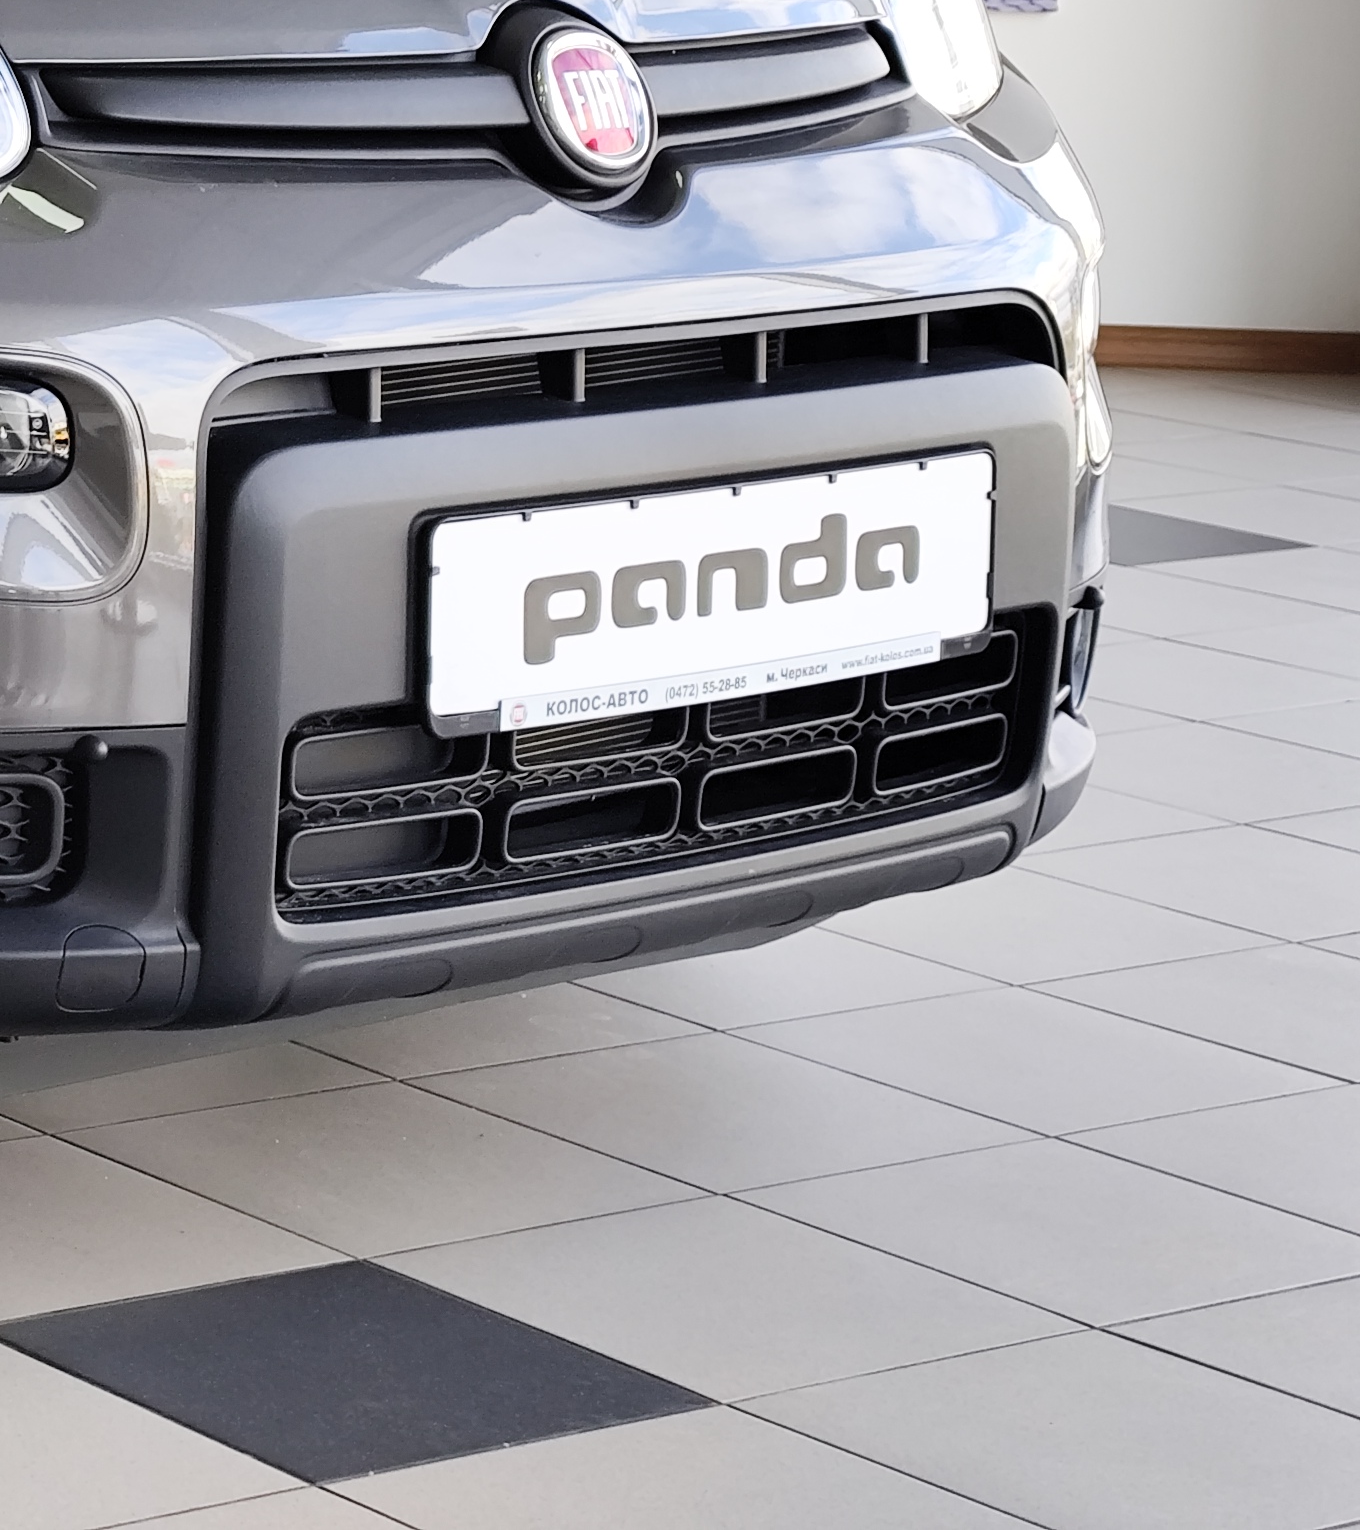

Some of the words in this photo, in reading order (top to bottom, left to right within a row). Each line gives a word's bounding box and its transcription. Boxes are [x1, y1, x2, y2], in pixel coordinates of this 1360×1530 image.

[563, 70, 630, 131] FIAT
[523, 513, 921, 665] panda
[546, 689, 649, 717] КОЛОС-АВТО
[665, 683, 699, 703] (0472)
[702, 676, 747, 699] 55-28-85
[781, 663, 828, 681] Черкаси
[841, 645, 934, 669] www.fiat-kolos.com.ua
